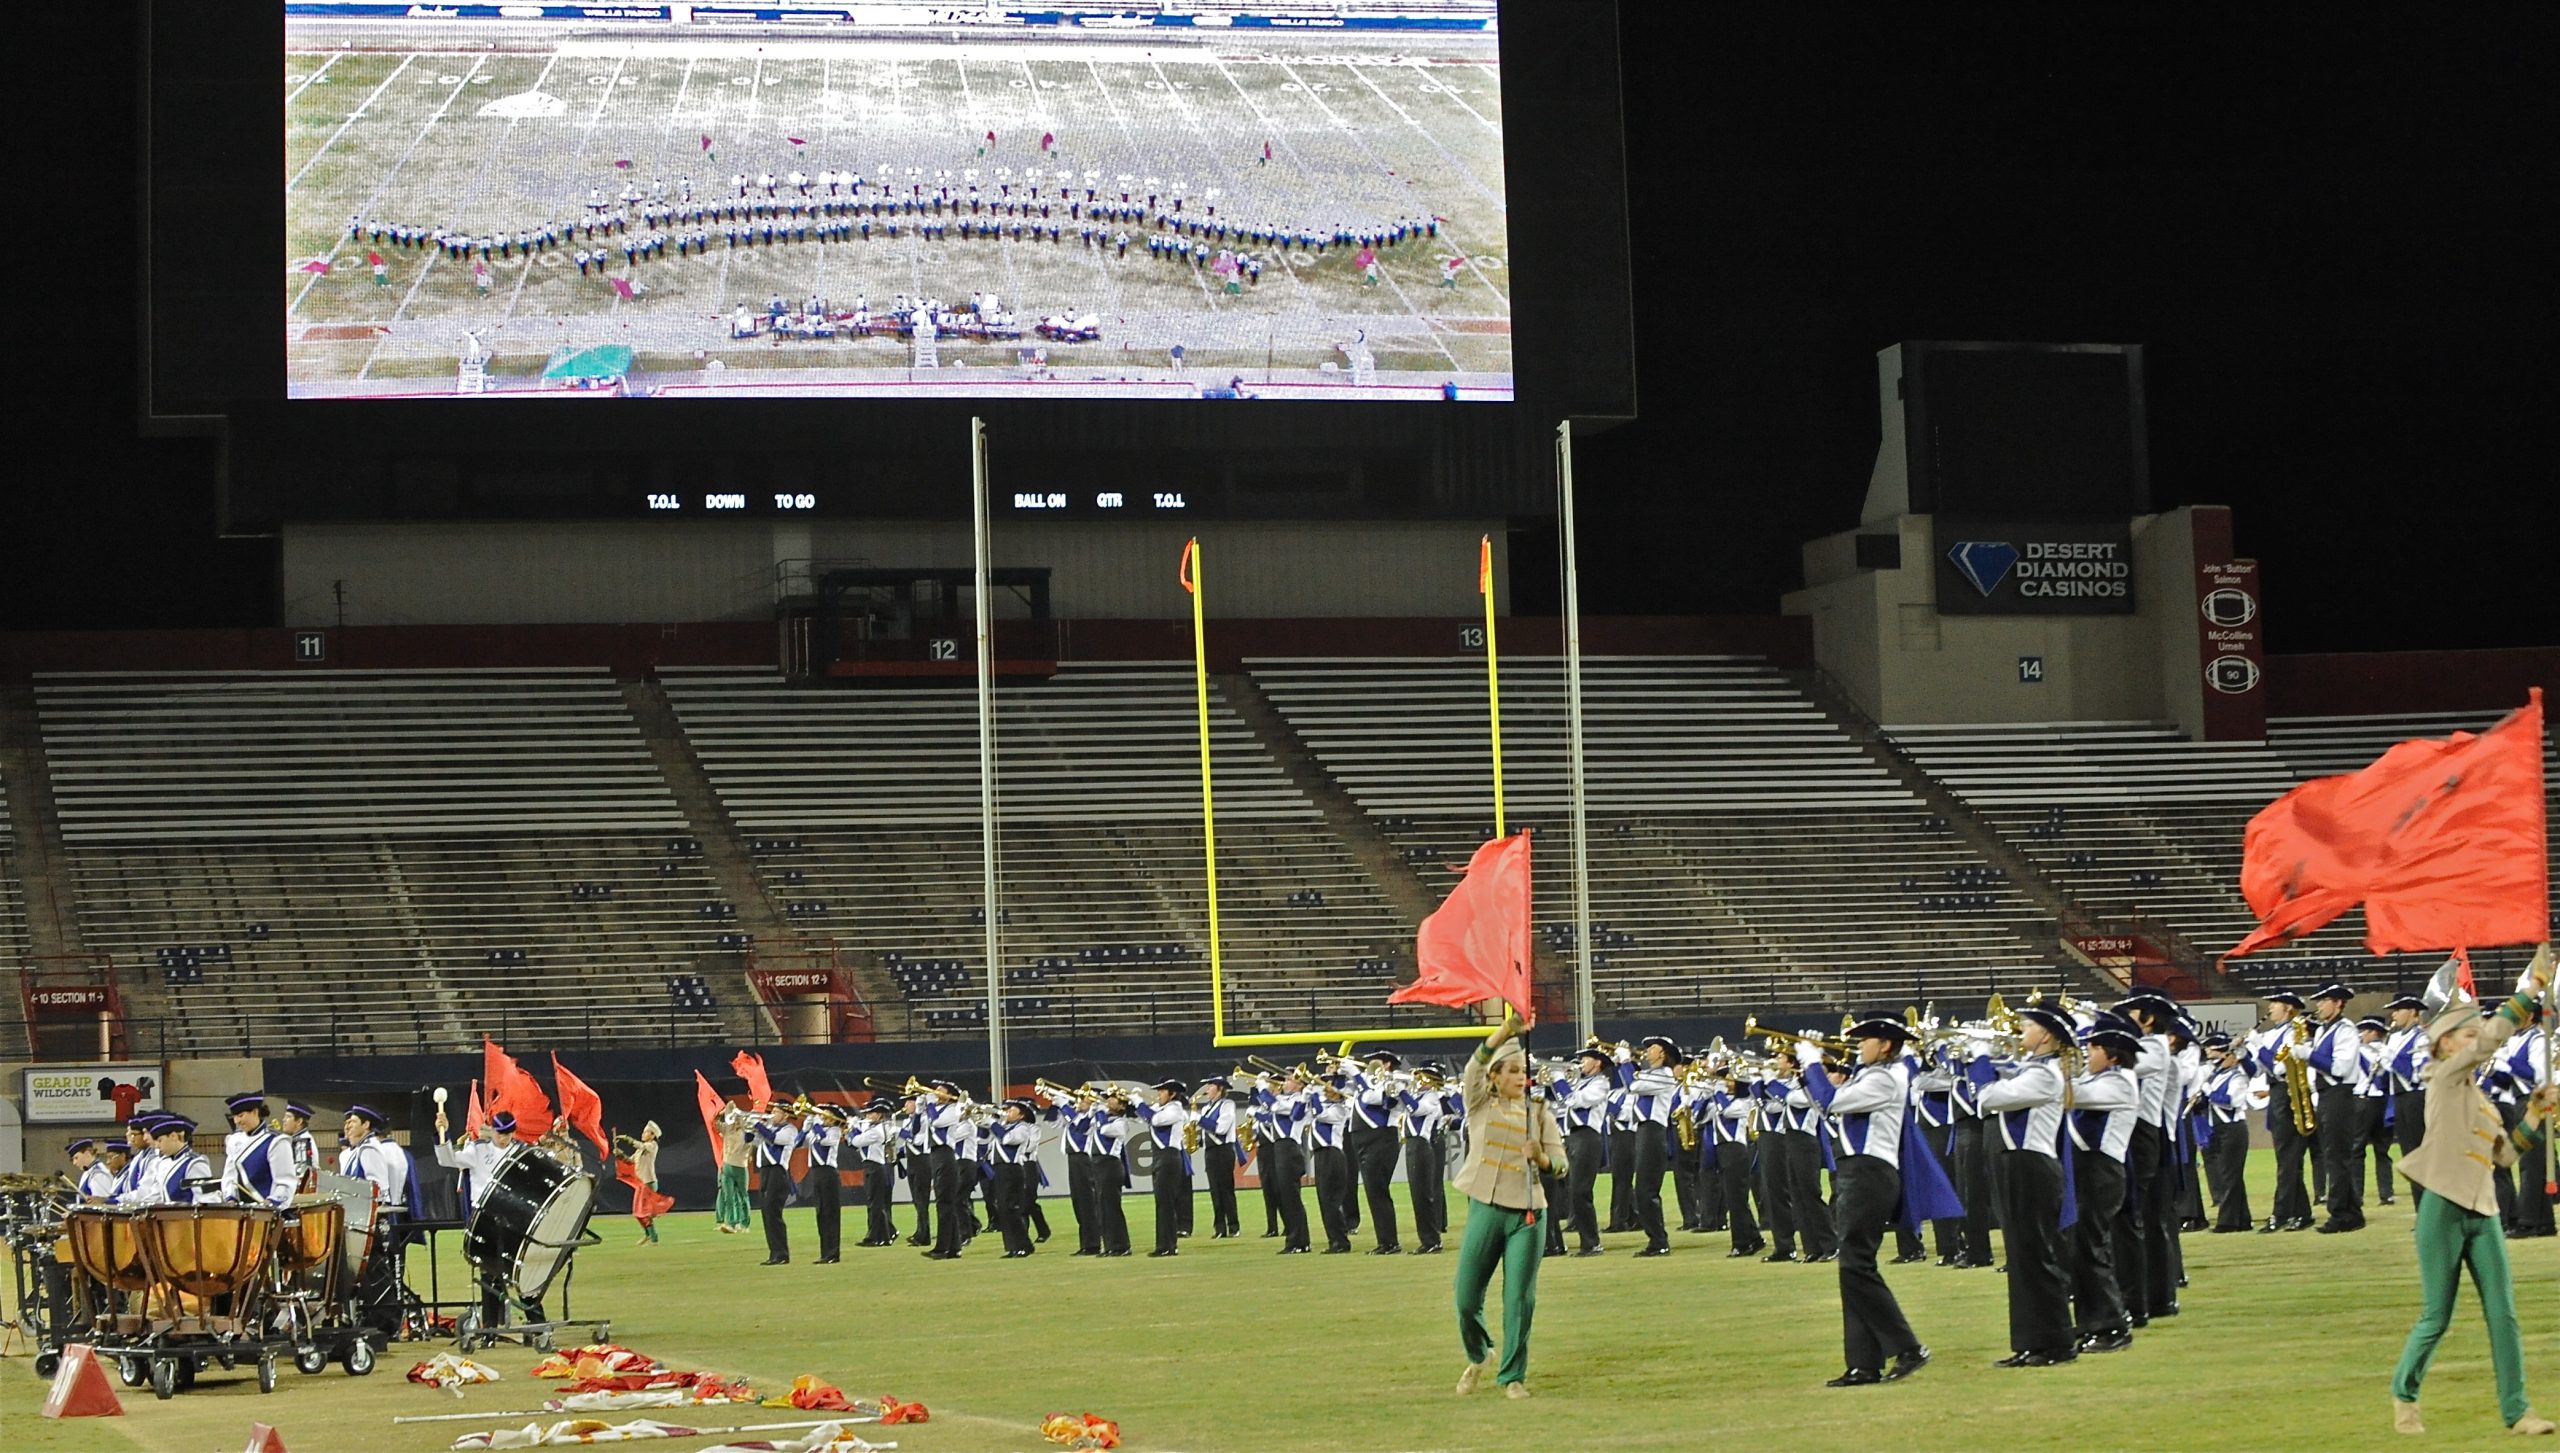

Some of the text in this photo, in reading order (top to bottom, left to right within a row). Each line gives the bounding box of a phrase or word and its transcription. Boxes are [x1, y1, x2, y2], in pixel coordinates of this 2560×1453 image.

[705, 494, 745, 509] DOWN
[774, 493, 815, 509] TO GO
[1014, 493, 1066, 508] BALL ON
[1096, 493, 1123, 508] QTR
[2026, 543, 2117, 559] DESERT
[2016, 562, 2129, 578] DIAMOND
[2202, 564, 2221, 573] John
[2020, 581, 2126, 597] CASINOS
[1460, 628, 1484, 647] 13
[2208, 631, 2253, 640] McCollins
[300, 637, 320, 656] 11
[932, 640, 956, 659] 12
[2218, 642, 2245, 651] Umeh
[2019, 660, 2042, 679] 14
[2226, 670, 2240, 680] 90
[774, 974, 809, 987] SECTION
[811, 974, 820, 985] 12
[39, 991, 96, 1004] 10 SECTION 11
[32, 1076, 92, 1089] GEAR UP
[33, 1088, 92, 1098] WILDCATS
